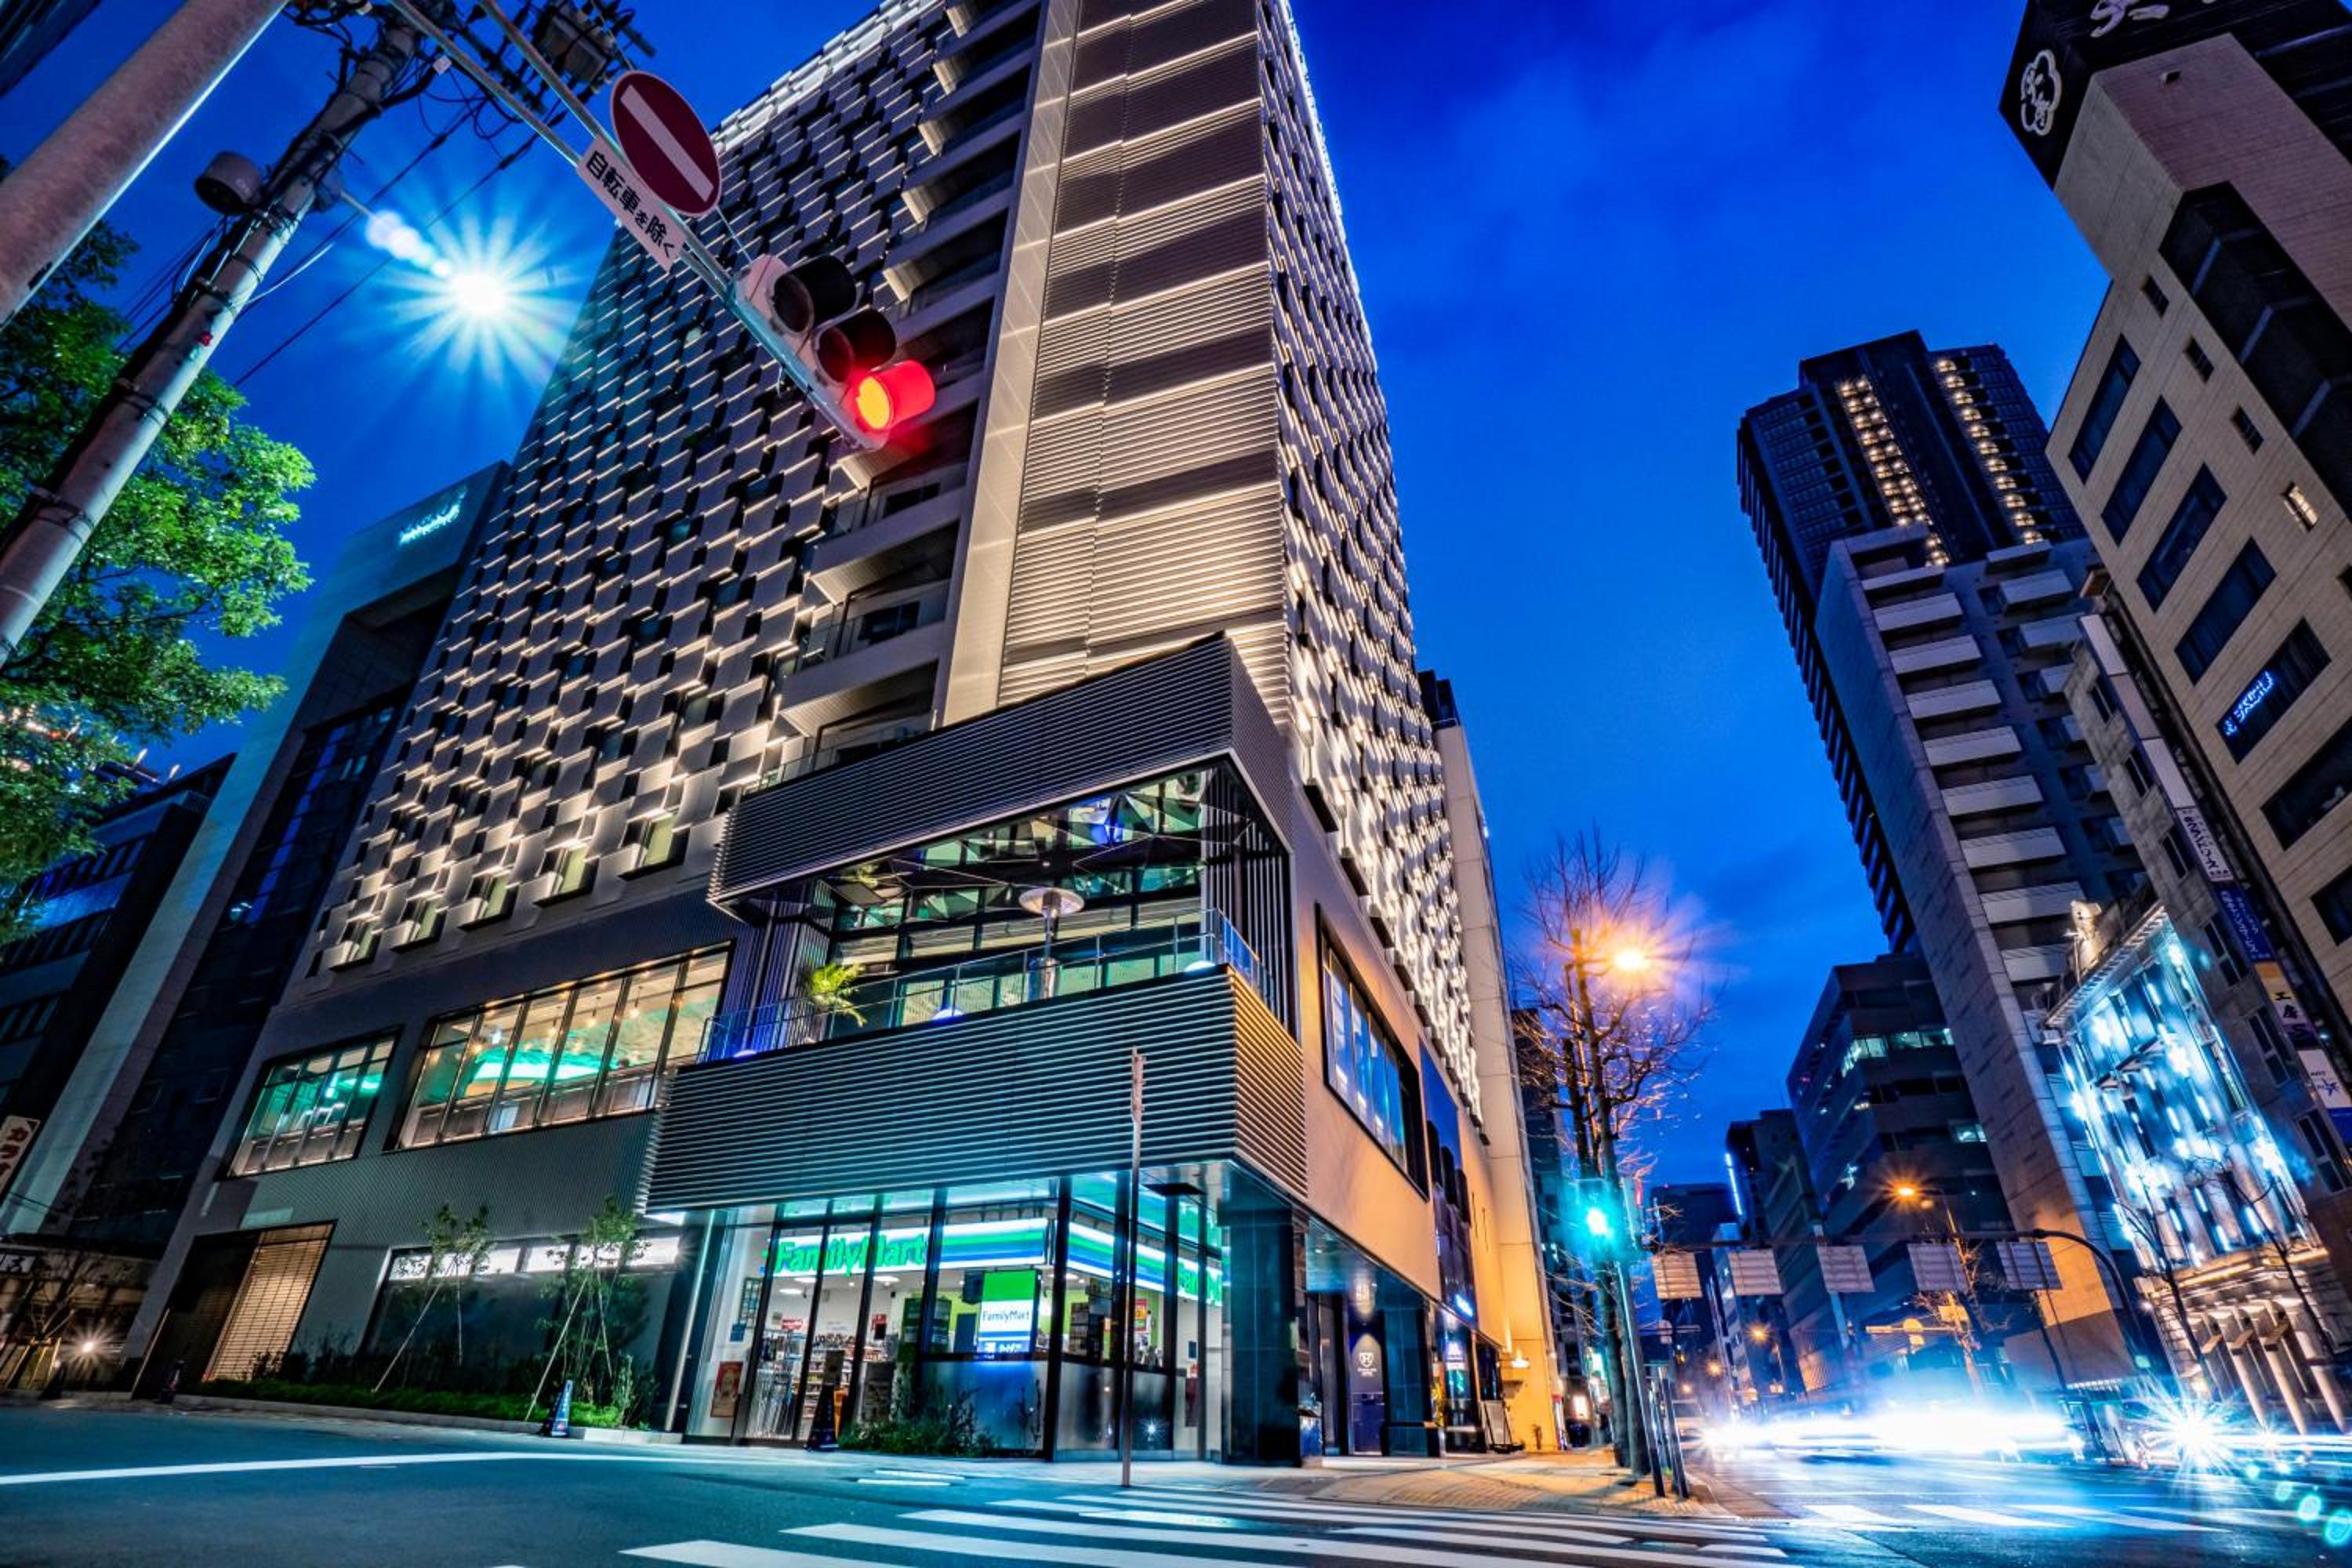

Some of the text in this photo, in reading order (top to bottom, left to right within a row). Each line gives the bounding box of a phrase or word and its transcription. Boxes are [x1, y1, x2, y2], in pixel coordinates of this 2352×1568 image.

[586, 150, 675, 258] 自転車を除く
[982, 1309, 1029, 1324] FamilyMart
